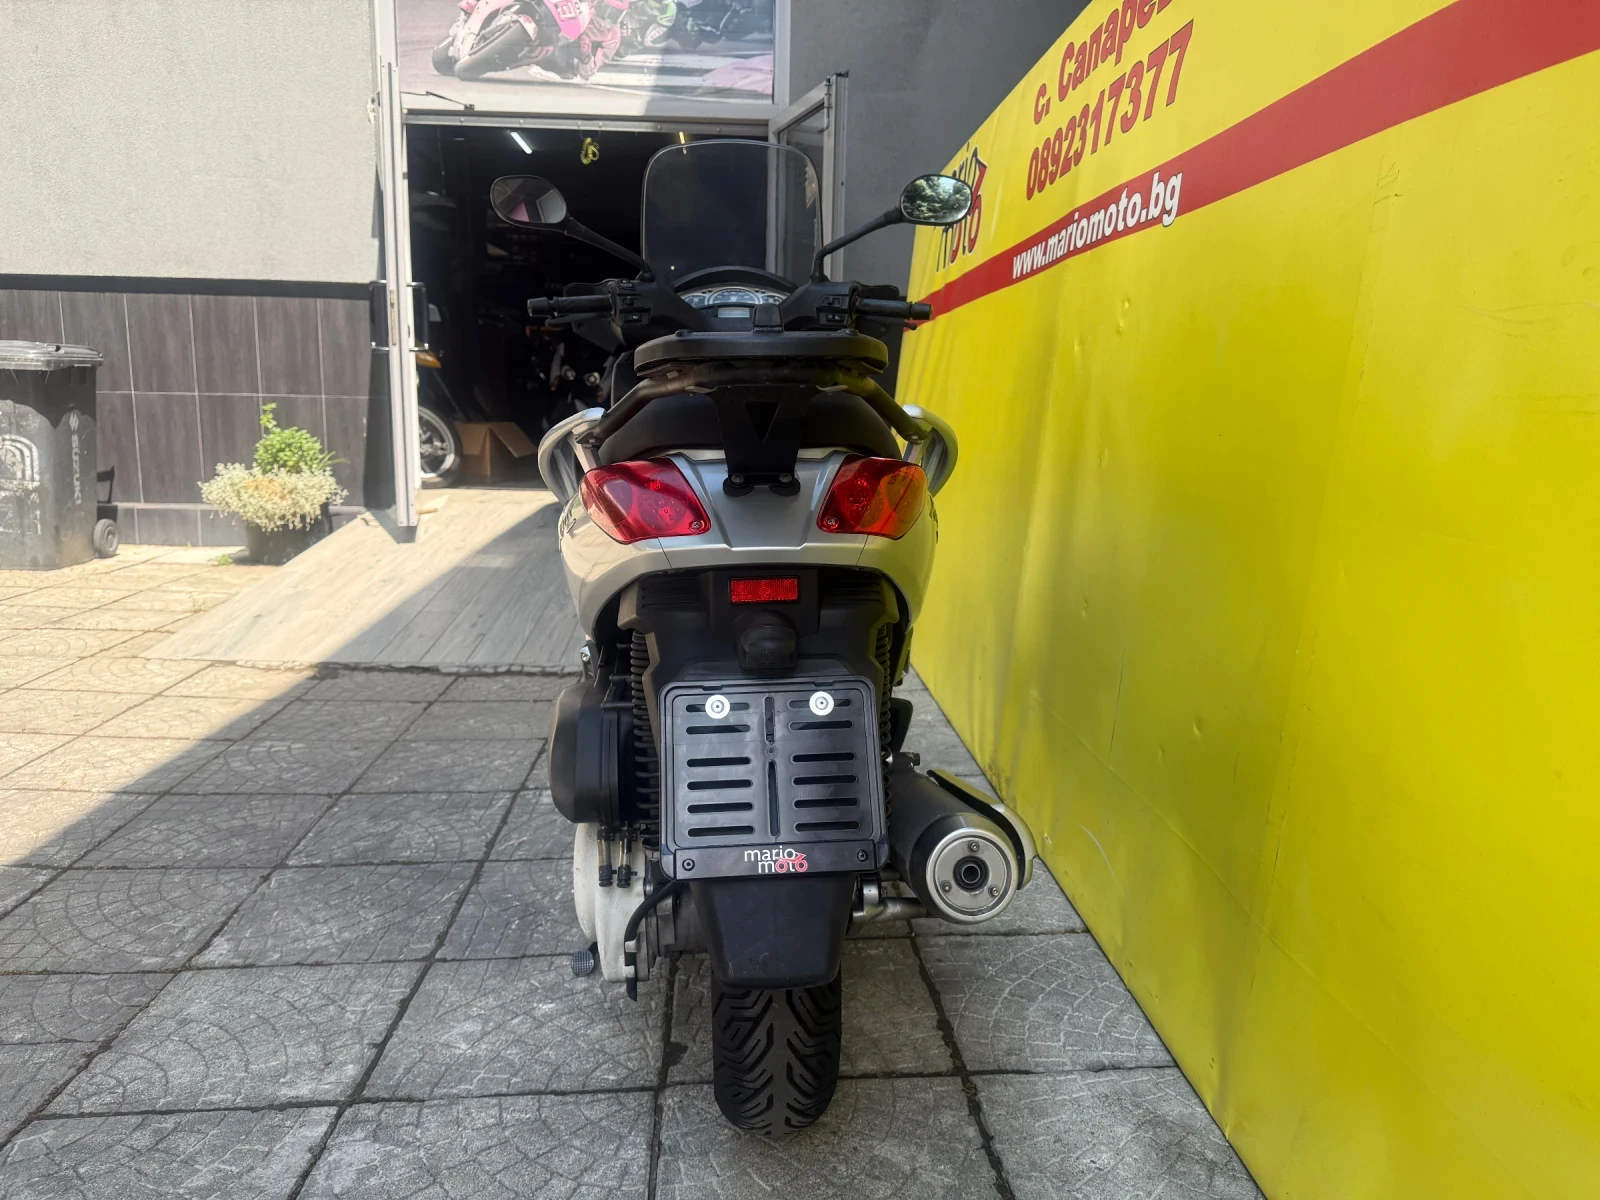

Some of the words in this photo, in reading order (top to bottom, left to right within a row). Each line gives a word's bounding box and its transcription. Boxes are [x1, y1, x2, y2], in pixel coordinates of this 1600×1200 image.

[1026, 18, 1194, 201] 0892317377
[1033, 83, 1051, 125] с.
[1012, 170, 1183, 279] www.mariomoto.bg
[744, 845, 796, 862] mario
[758, 859, 808, 873] moto
